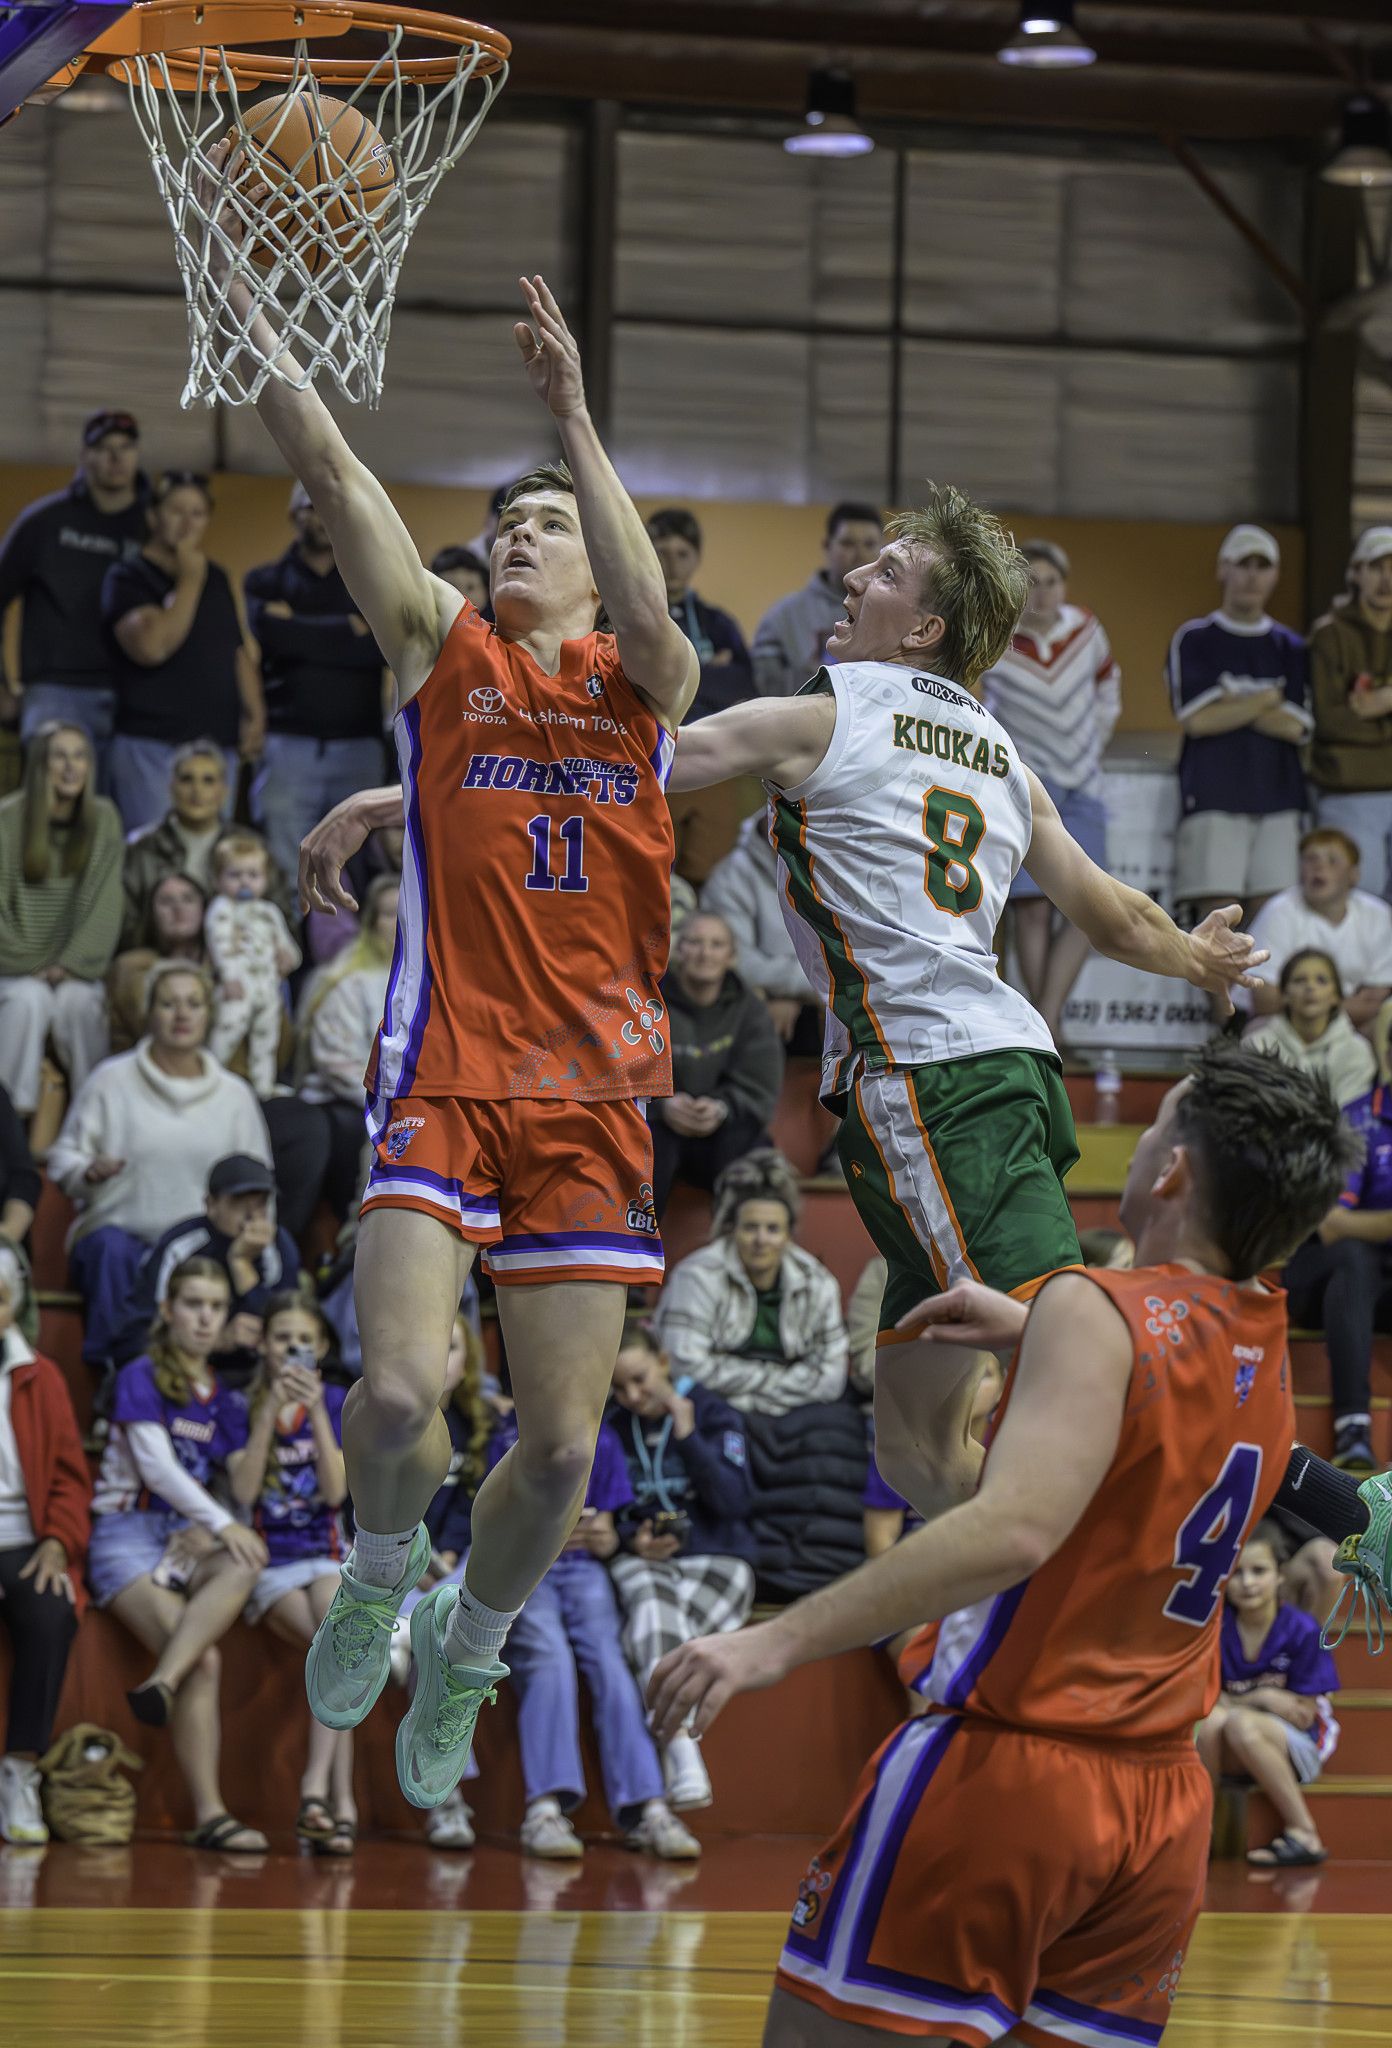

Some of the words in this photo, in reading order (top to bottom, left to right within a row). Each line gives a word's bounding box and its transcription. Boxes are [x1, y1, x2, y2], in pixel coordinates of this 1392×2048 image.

[462, 711, 508, 726] TOYOTA
[519, 708, 585, 730] Hosham
[562, 757, 638, 776] HORSHAM
[893, 714, 1010, 779] KOOKAS
[462, 754, 640, 806] HORNETS
[525, 814, 589, 893] 11
[922, 785, 986, 918] 8
[627, 1210, 654, 1232] CBL
[1162, 1442, 1263, 1627] 4
